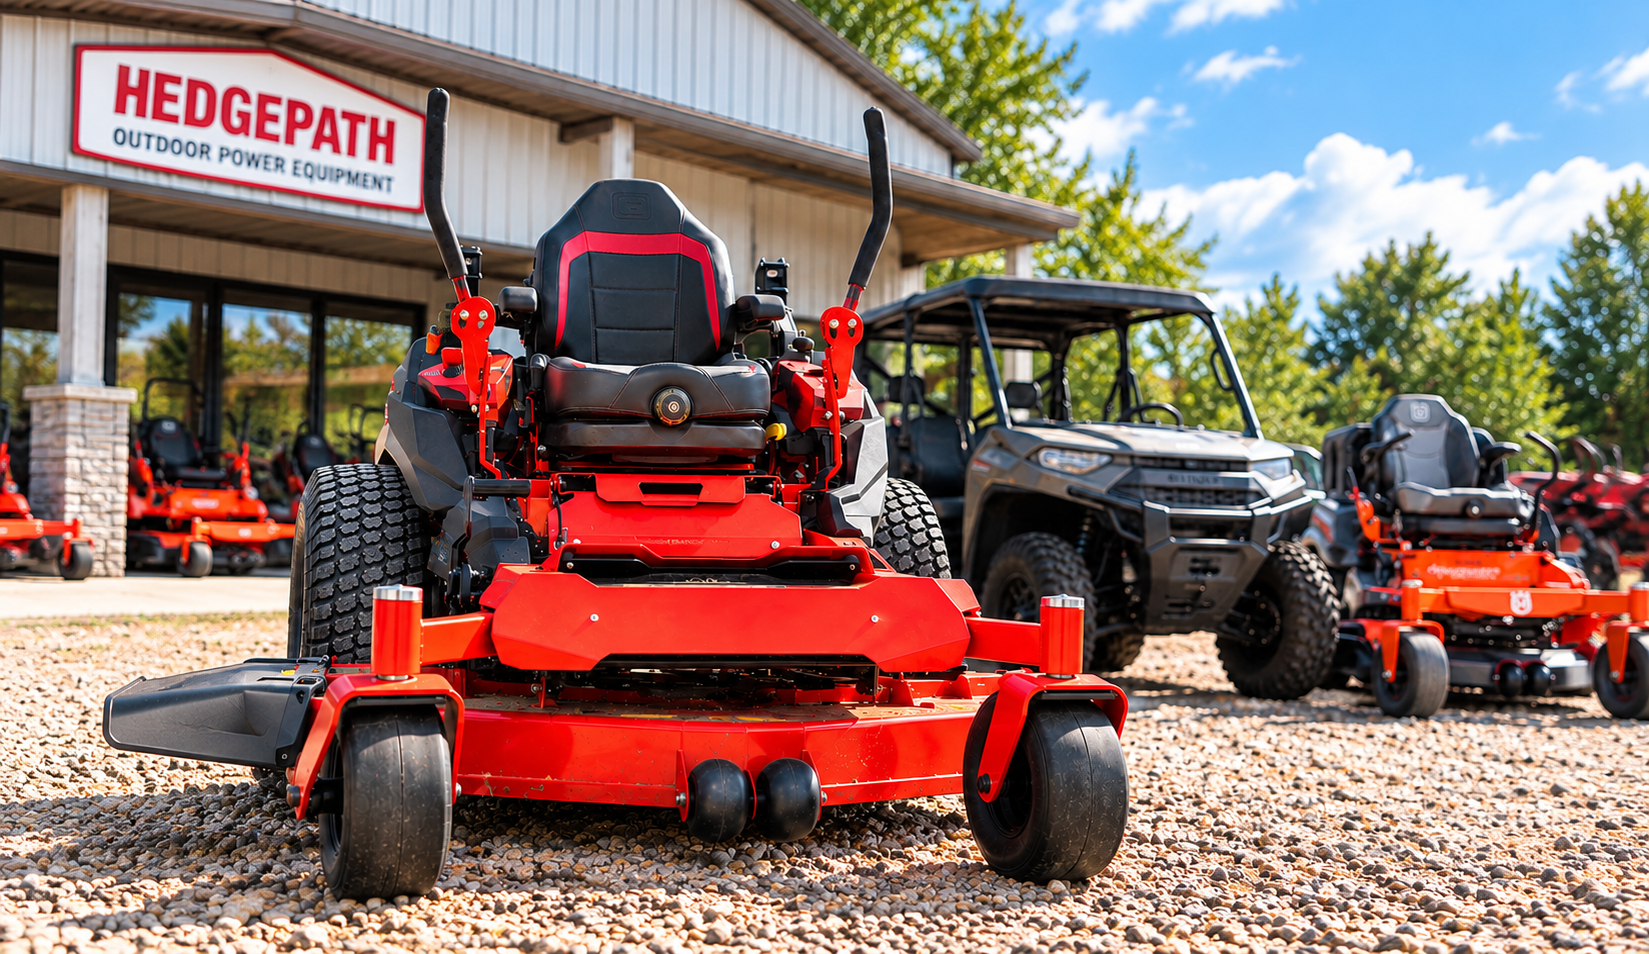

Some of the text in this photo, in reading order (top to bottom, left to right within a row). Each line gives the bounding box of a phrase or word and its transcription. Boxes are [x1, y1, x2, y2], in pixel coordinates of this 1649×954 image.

[115, 64, 396, 165] HEDGEPATH
[113, 127, 394, 193] OUTDOOR POWER EQUIPMENT
